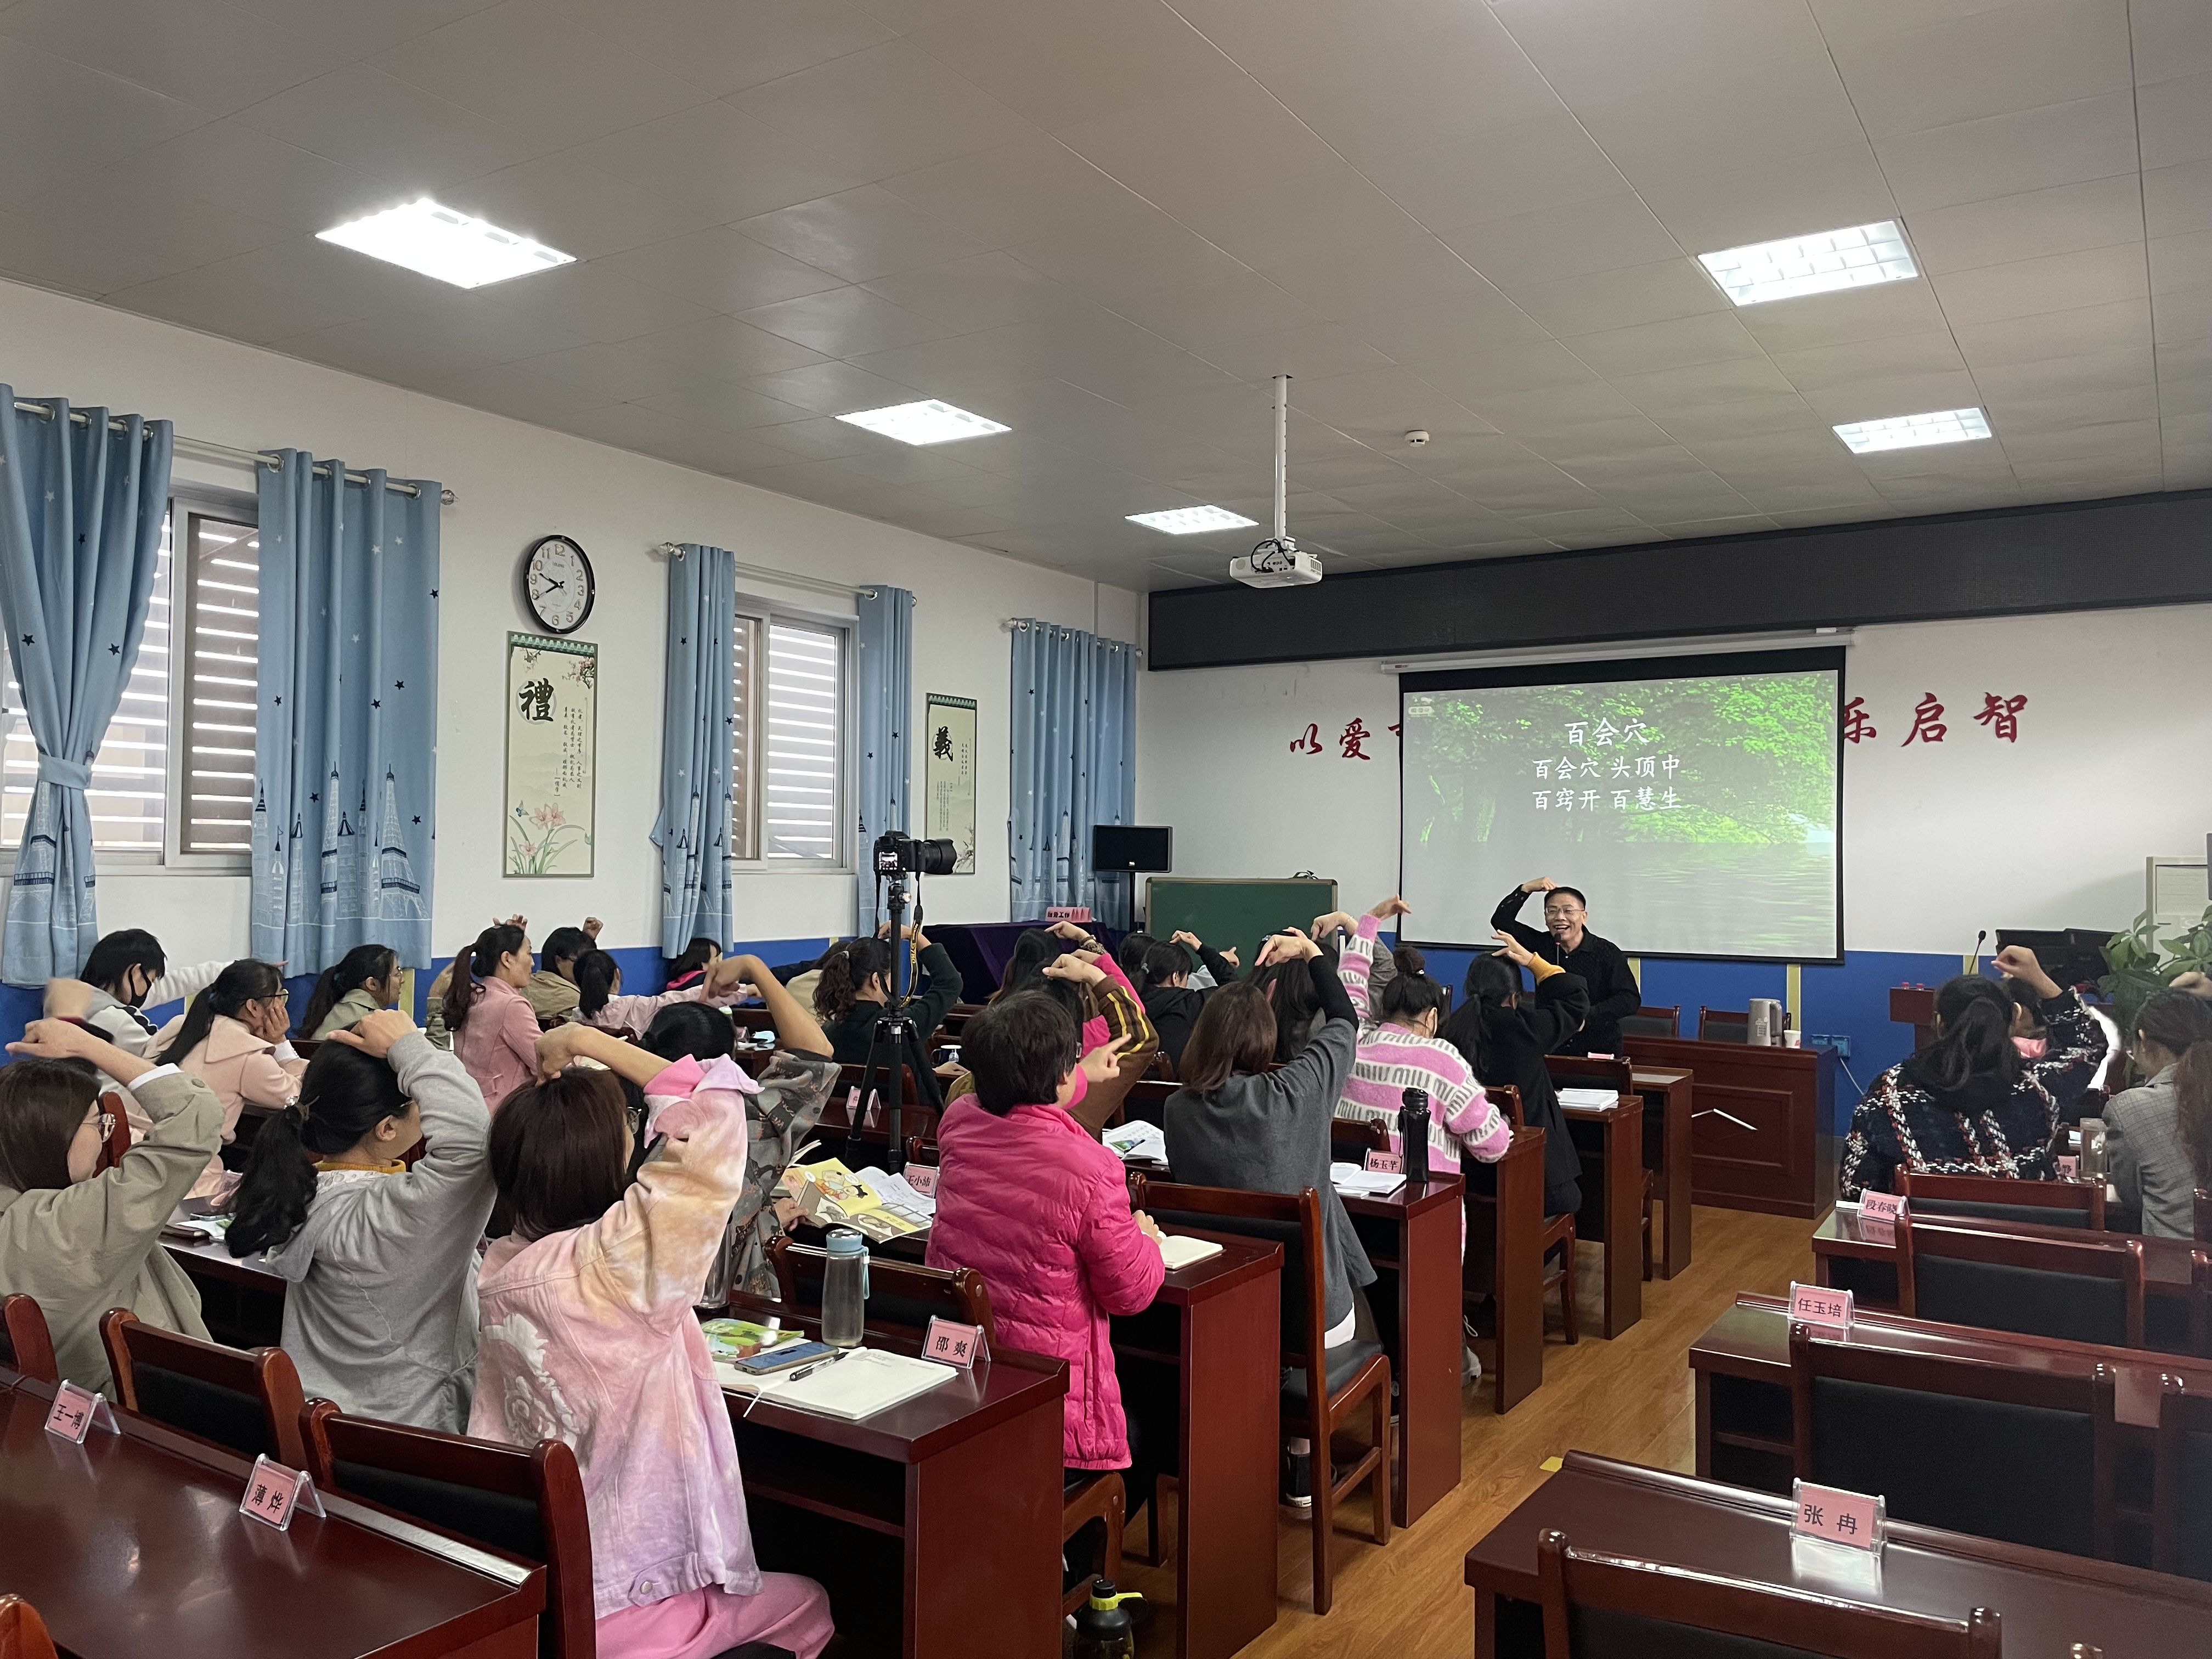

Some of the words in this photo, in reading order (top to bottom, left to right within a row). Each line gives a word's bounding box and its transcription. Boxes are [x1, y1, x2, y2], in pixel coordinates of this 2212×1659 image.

[541, 546, 550, 559] 11
[554, 544, 565, 556] 12
[532, 558, 543, 571] 10
[571, 555, 574, 567] 1
[530, 573, 537, 585] 9
[576, 569, 583, 582] 2
[532, 589, 539, 600] 8
[578, 585, 584, 596] 3
[539, 605, 546, 617] 7
[574, 599, 582, 611] 4
[552, 615, 559, 626] 6
[566, 611, 574, 623] 5
[519, 678, 554, 721] 禮
[1565, 717, 1650, 746] 百会穴
[1290, 718, 1400, 760] 以爱
[1533, 756, 1601, 780] 百会穴
[1611, 754, 1680, 780] 头顶中
[1533, 787, 1600, 811] 百窍开
[1611, 786, 1681, 811] 百慧生
[1798, 1298, 1842, 1317] 任玉培
[935, 1336, 968, 1358] 邵爽
[251, 1484, 284, 1513] 薄烨
[1804, 1504, 1858, 1534] 张冉
